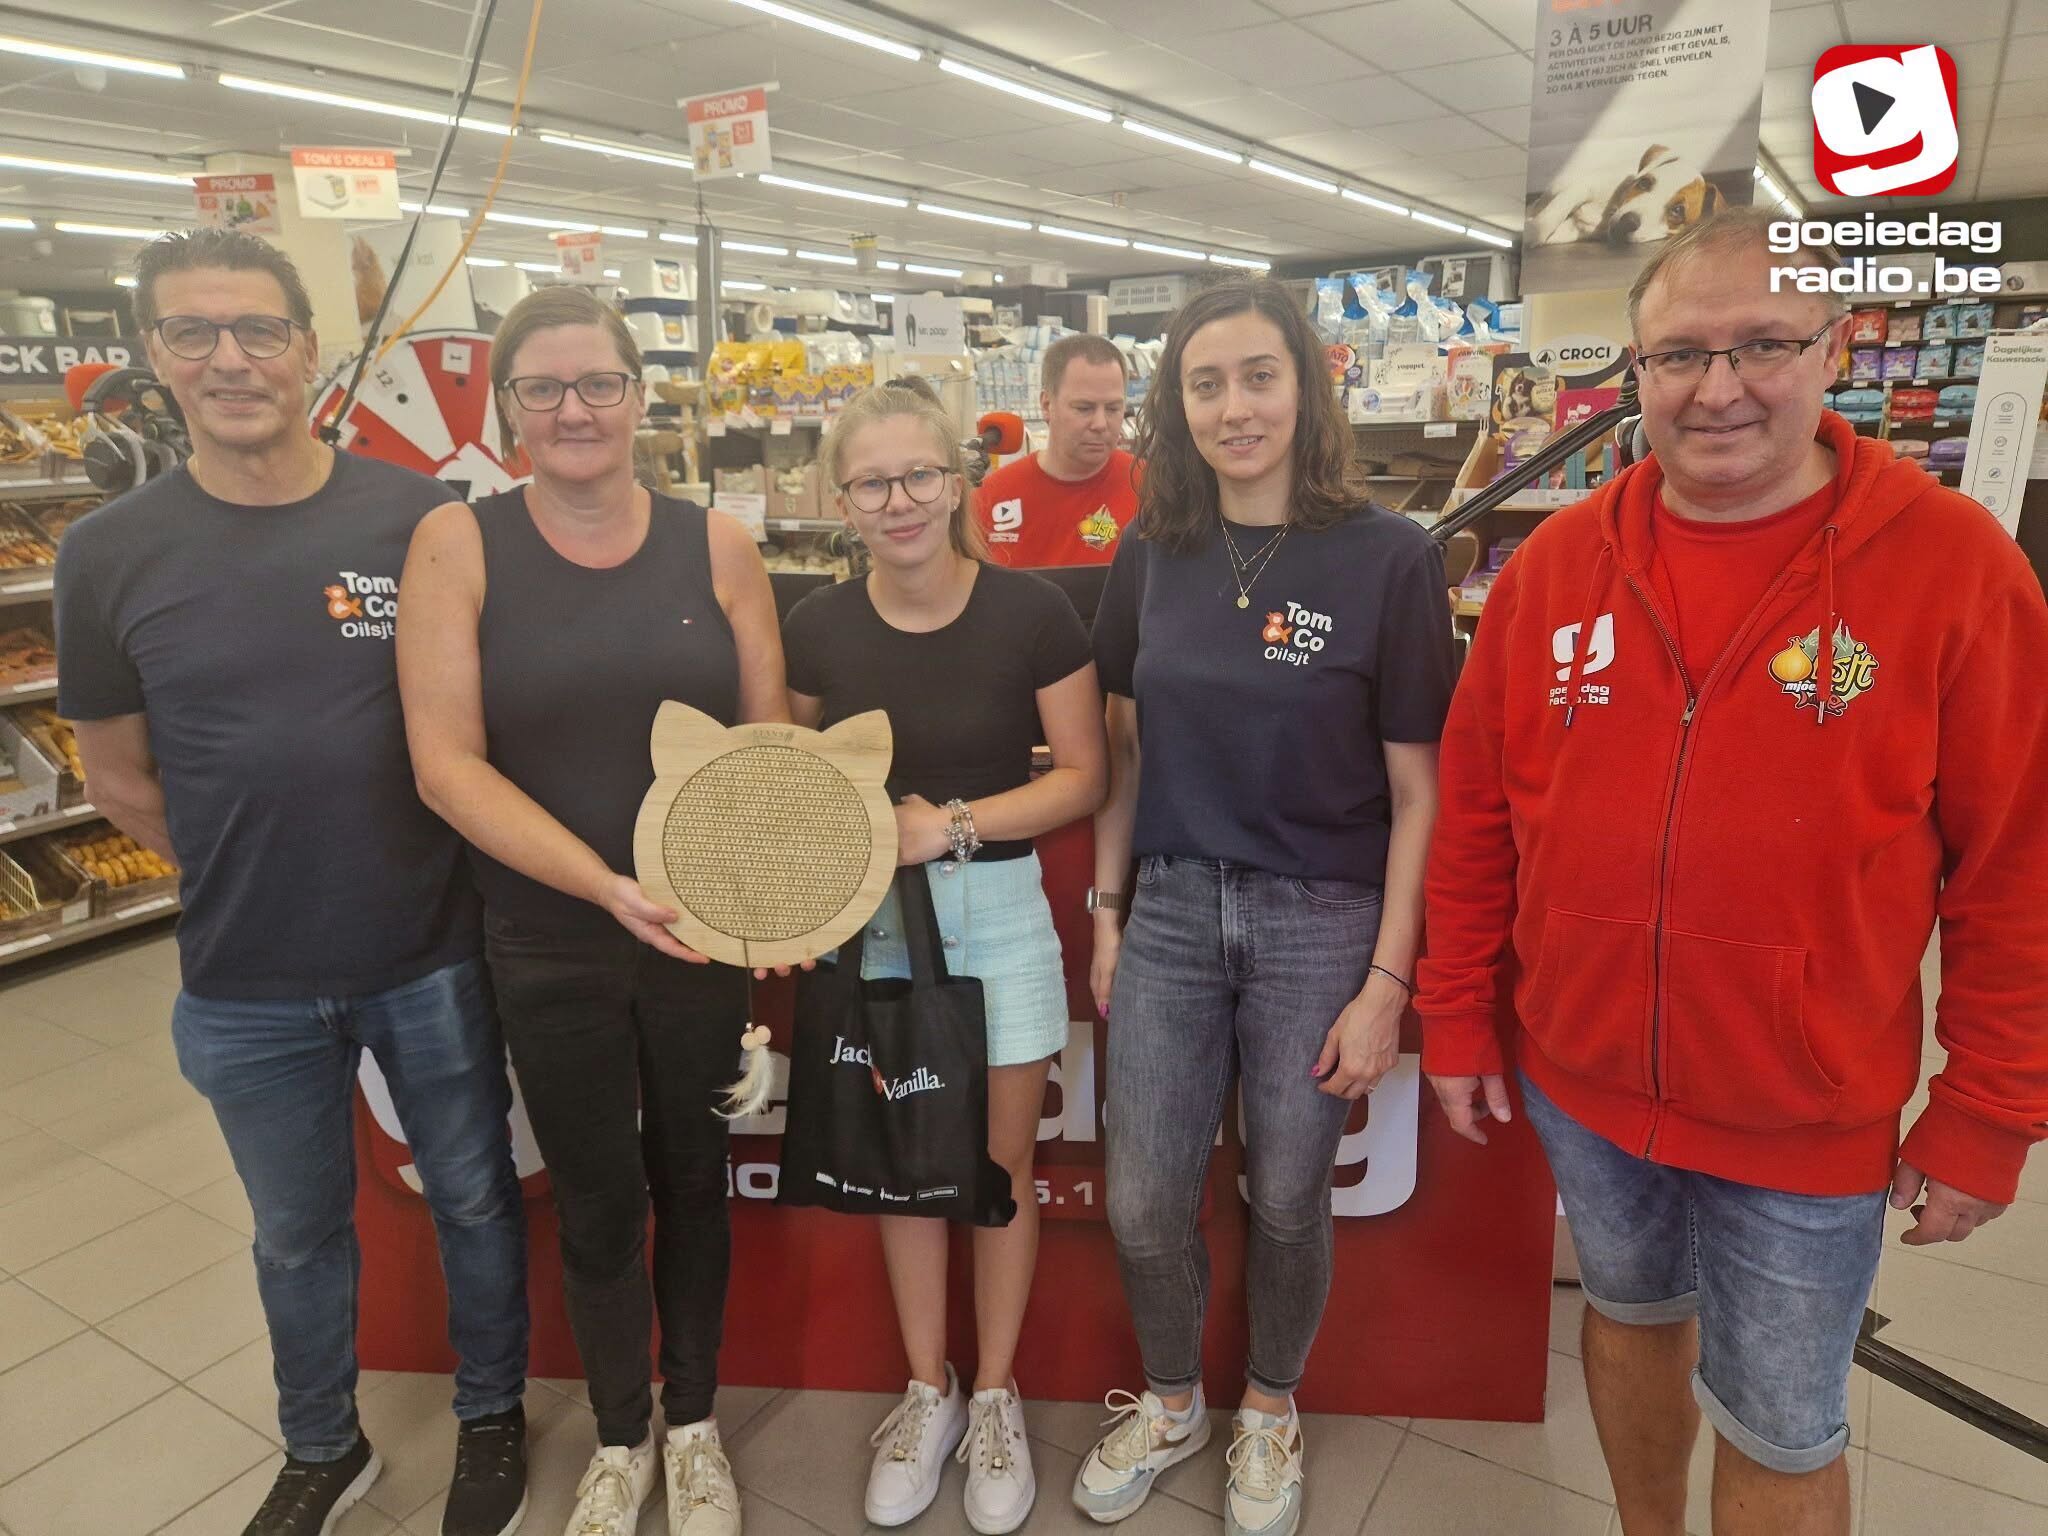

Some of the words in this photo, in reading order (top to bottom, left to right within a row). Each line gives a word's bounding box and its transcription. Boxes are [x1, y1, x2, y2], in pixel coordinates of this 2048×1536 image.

[1550, 29, 1562, 47] 3
[1589, 24, 1601, 41] 5
[1607, 14, 1654, 38] UUR
[1567, 45, 1586, 57] DAG
[1654, 31, 1682, 44] BEZIG
[1683, 27, 1703, 38] ZIJN
[1704, 24, 1724, 35] MET
[1609, 51, 1626, 62] ALS
[1626, 49, 1645, 60] DAT
[1645, 44, 1666, 56] NIET
[1668, 41, 1686, 53] HET
[1687, 38, 1718, 50] GEVAL
[1547, 71, 1566, 83] DAN
[1567, 68, 1591, 81] GAAT
[1639, 57, 1662, 69] SNEL
[1586, 72, 1635, 89] VERVELING
[703, 94, 748, 118] PROMO
[343, 155, 386, 168] DEALS
[209, 175, 257, 191] PROMO
[1559, 346, 1611, 361] CROCI
[1986, 355, 2046, 364] Kauwsnacks
[1993, 345, 2043, 355] Dagelijkse
[375, 370, 395, 388] 12
[339, 571, 398, 594] Tom
[365, 595, 398, 618] Co
[1286, 601, 1333, 632] Tom
[341, 621, 395, 640] Oilsjt
[1293, 628, 1325, 652] Co
[1264, 646, 1310, 666] Oilsjt
[1549, 683, 1610, 698] goedag
[881, 1066, 946, 1102] Vanilla.
